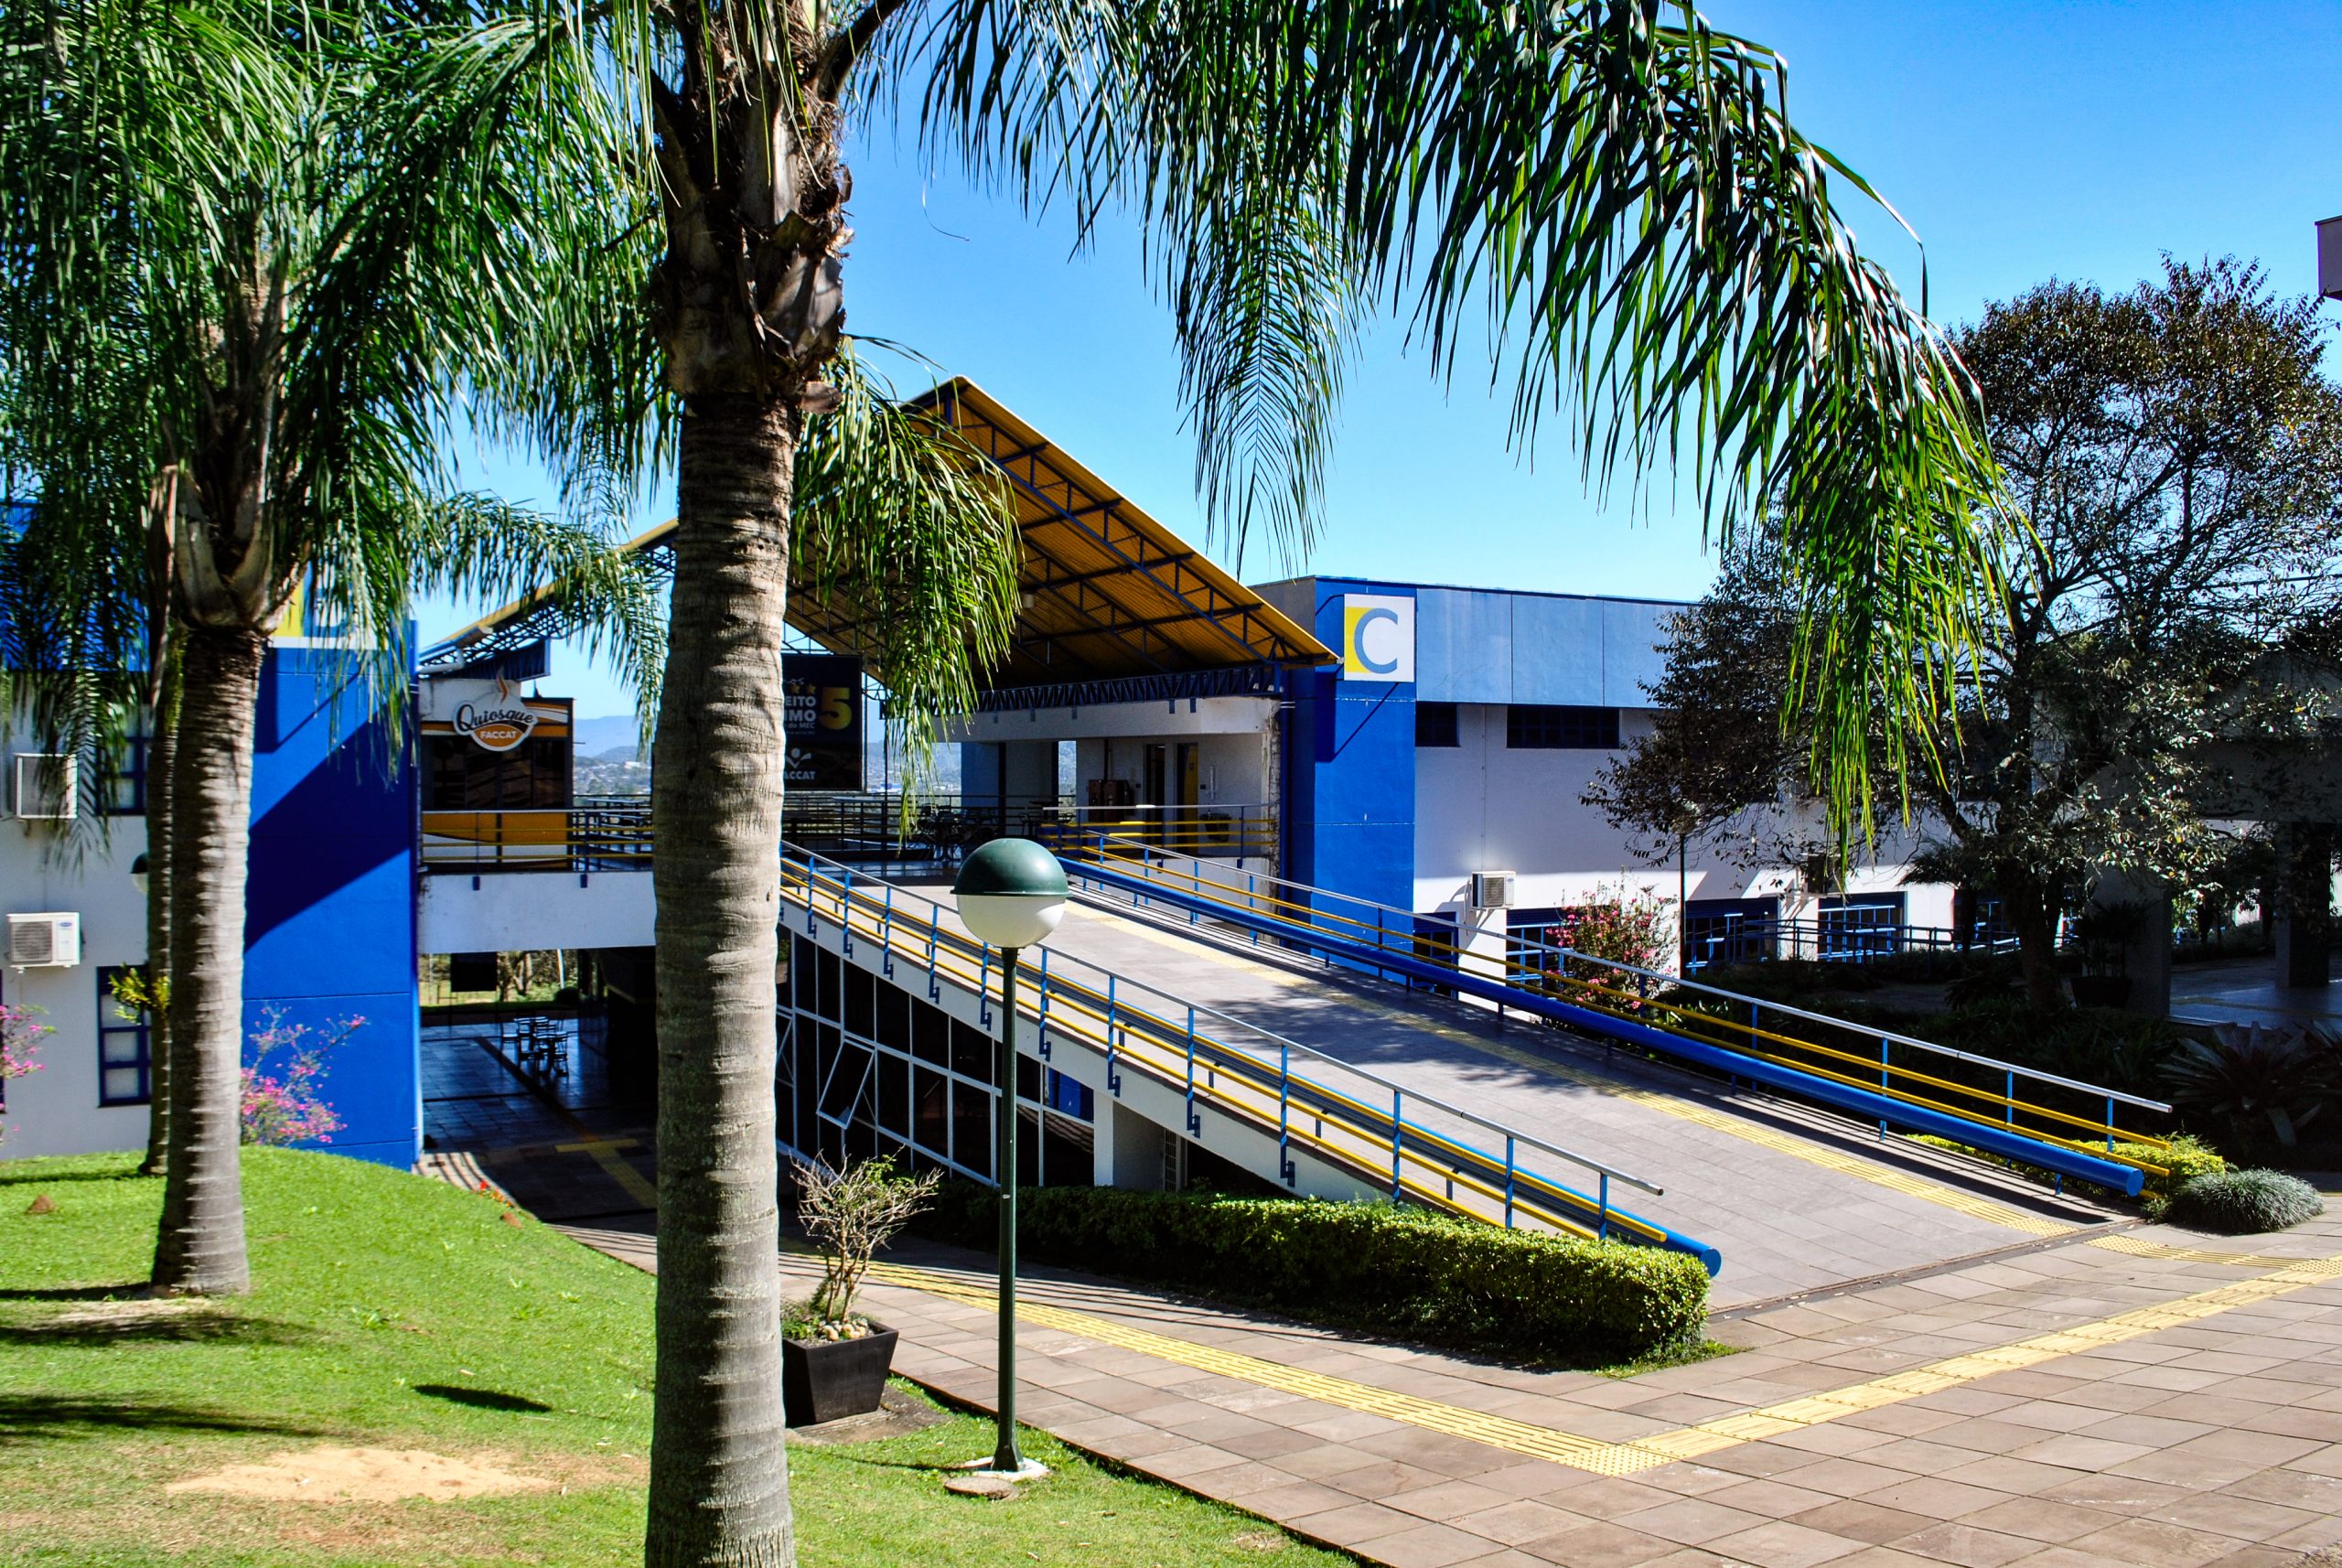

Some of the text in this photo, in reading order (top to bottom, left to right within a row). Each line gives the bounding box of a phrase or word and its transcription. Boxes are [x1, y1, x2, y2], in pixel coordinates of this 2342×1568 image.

[1354, 607, 1398, 674] C
[786, 696, 816, 707] EITO
[820, 687, 852, 730] 5
[457, 703, 533, 732] Quiosque
[784, 710, 816, 722] IMO
[480, 731, 517, 739] FACCAT
[785, 771, 816, 779] ACCAT
